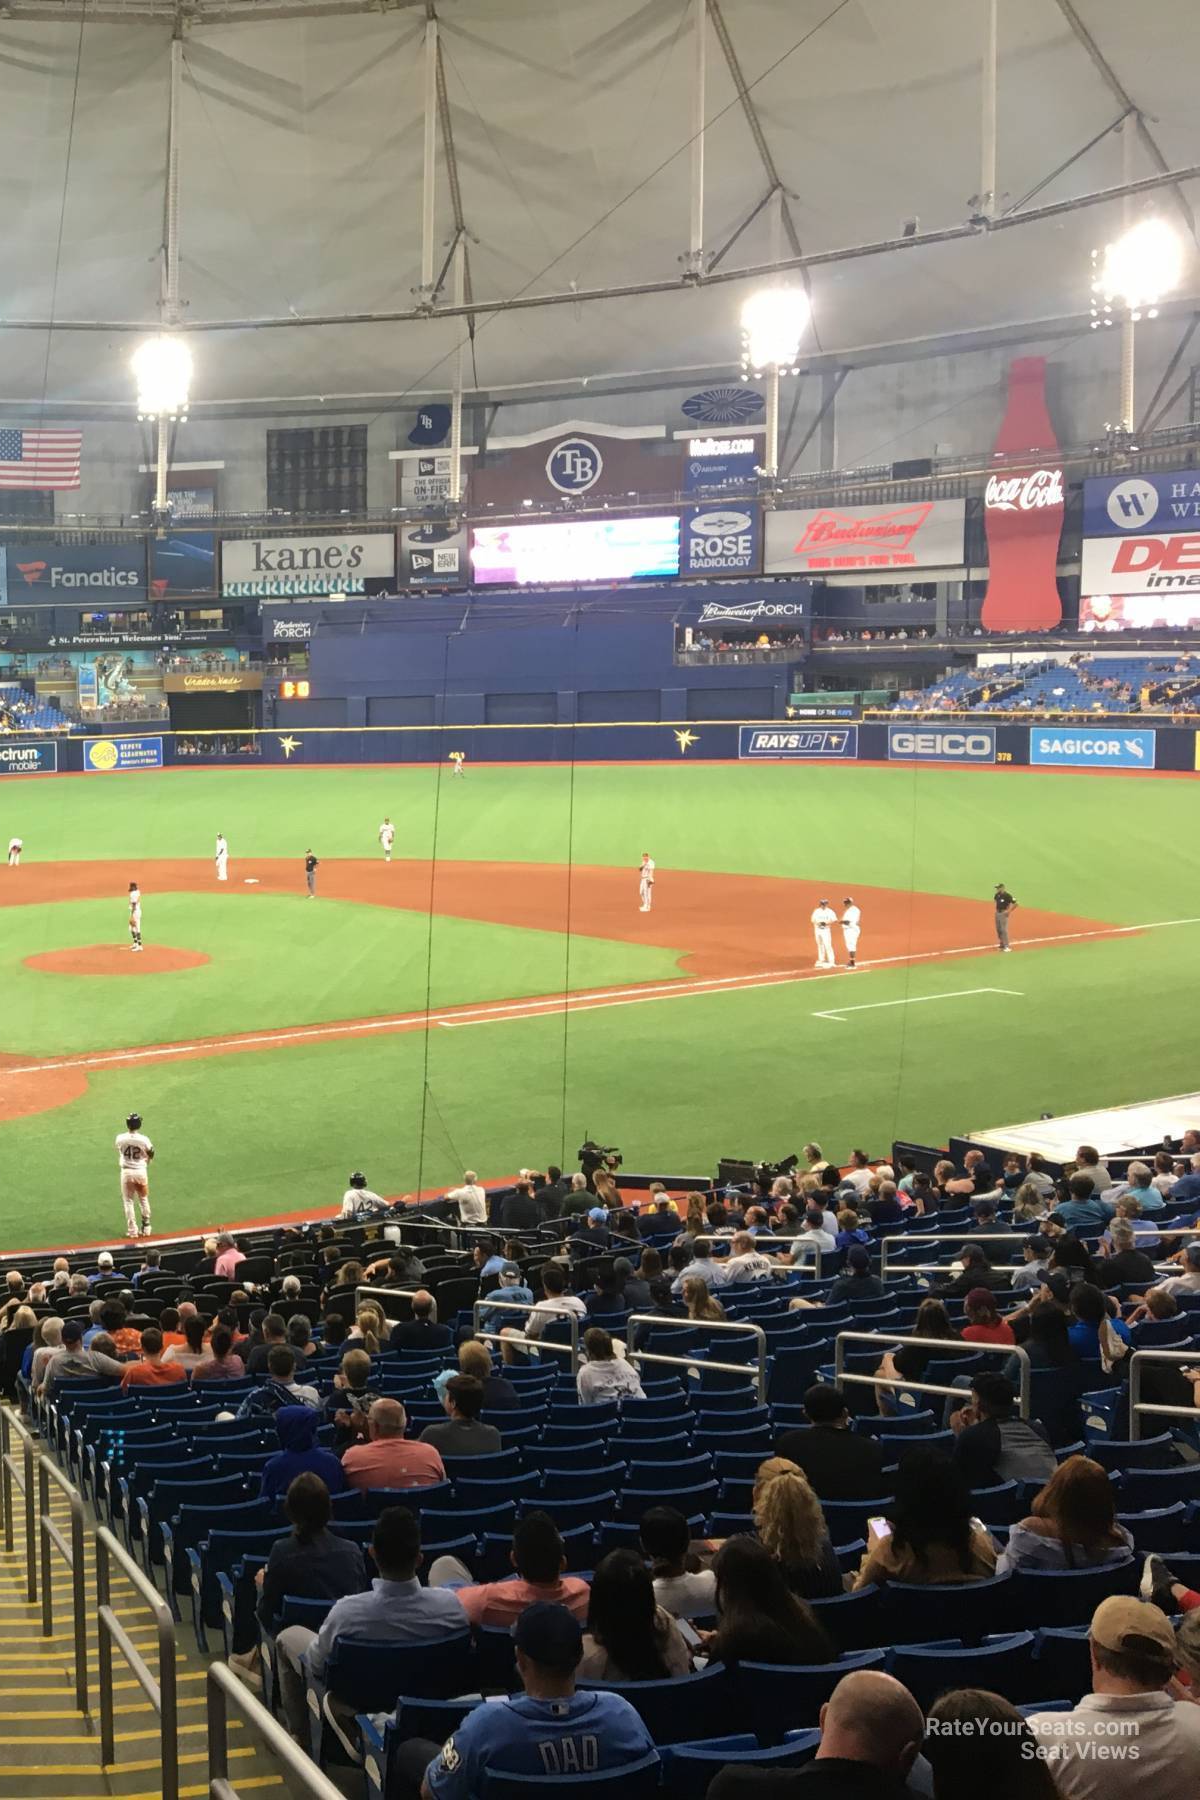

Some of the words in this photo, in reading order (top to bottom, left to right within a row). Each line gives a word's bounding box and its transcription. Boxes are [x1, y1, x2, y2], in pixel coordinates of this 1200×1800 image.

[557, 449, 593, 483] TB
[985, 470, 1064, 511] Coca-Cola
[808, 520, 919, 541] Budweiser
[252, 541, 364, 572] kane's
[690, 535, 752, 557] ROSE
[690, 556, 752, 569] RADIOLOGY
[51, 567, 139, 588] Fanatics
[707, 606, 759, 617] Budweiser
[759, 603, 802, 615] PORCH
[59, 636, 70, 644] St.
[72, 635, 120, 644] Petersburg
[122, 635, 161, 643] Welcomes
[273, 628, 310, 638] PORCH
[892, 733, 992, 756] GEICO
[1039, 739, 1121, 756] SAGICOR
[9, 761, 38, 772] mobile
[123, 1145, 141, 1160] 42
[539, 1735, 600, 1775] DAD
